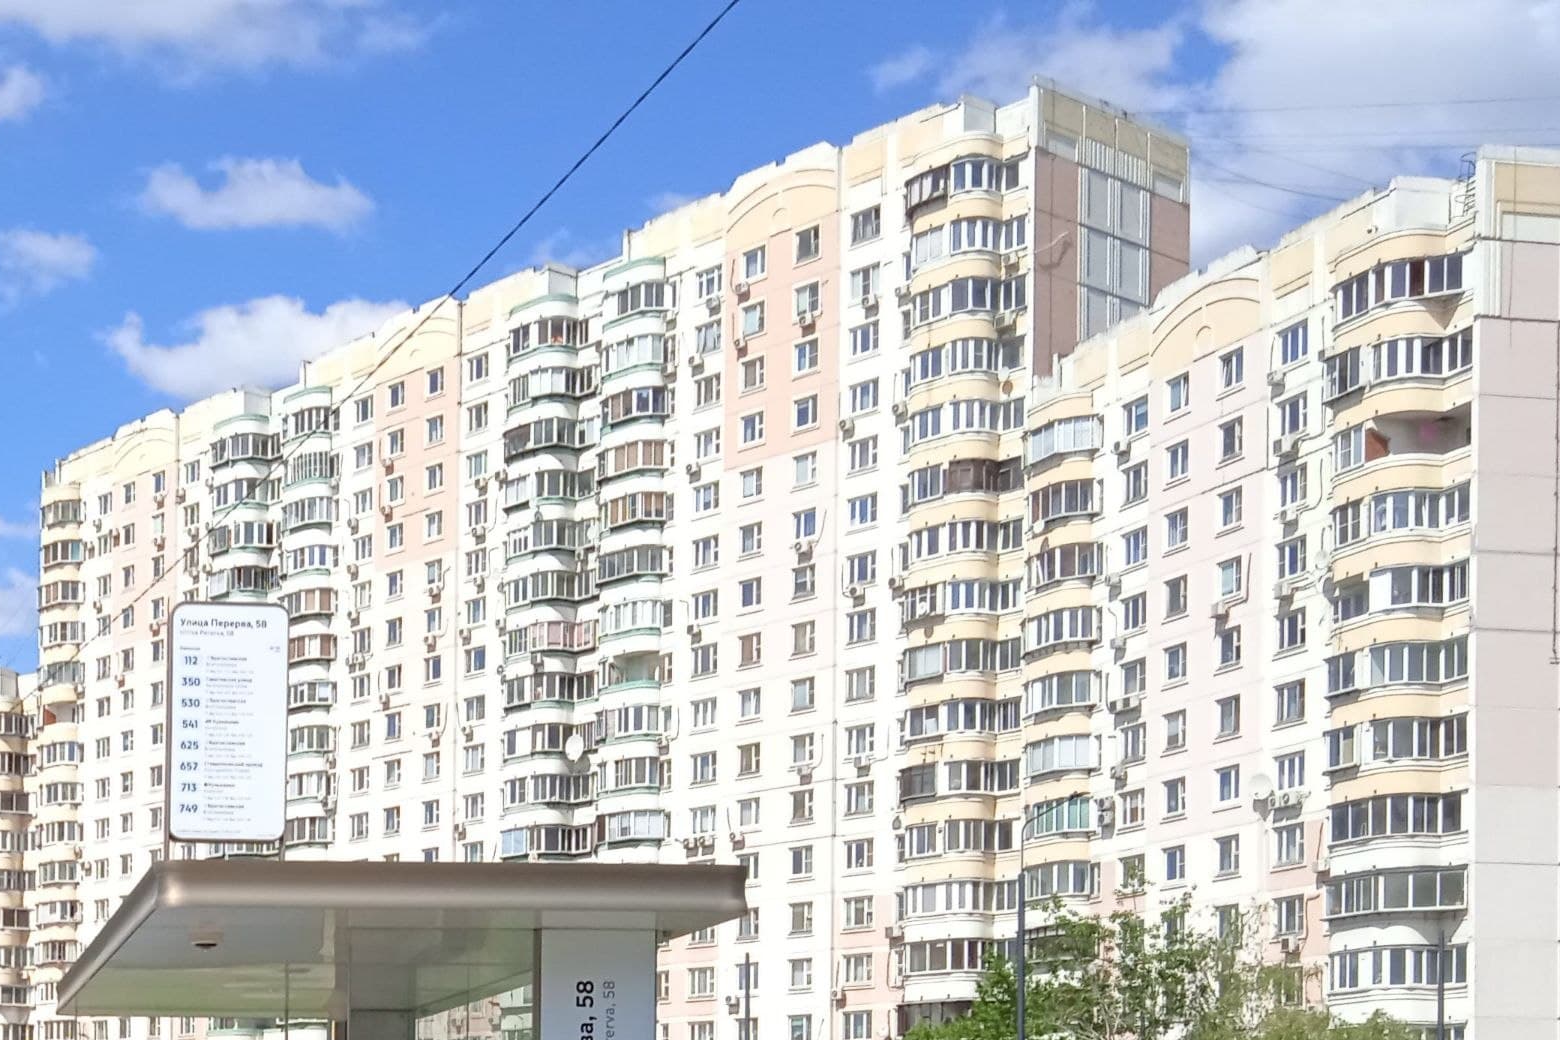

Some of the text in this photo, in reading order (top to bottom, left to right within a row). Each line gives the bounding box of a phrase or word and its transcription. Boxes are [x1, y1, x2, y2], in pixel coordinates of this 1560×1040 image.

[184, 656, 198, 665] 112
[182, 677, 200, 686] 350
[181, 698, 200, 708] 530
[182, 720, 198, 729] 541
[180, 740, 199, 750] 625
[181, 783, 197, 792] 713
[180, 804, 198, 813] 749
[576, 980, 594, 1008] 58
[603, 980, 615, 999] 58
